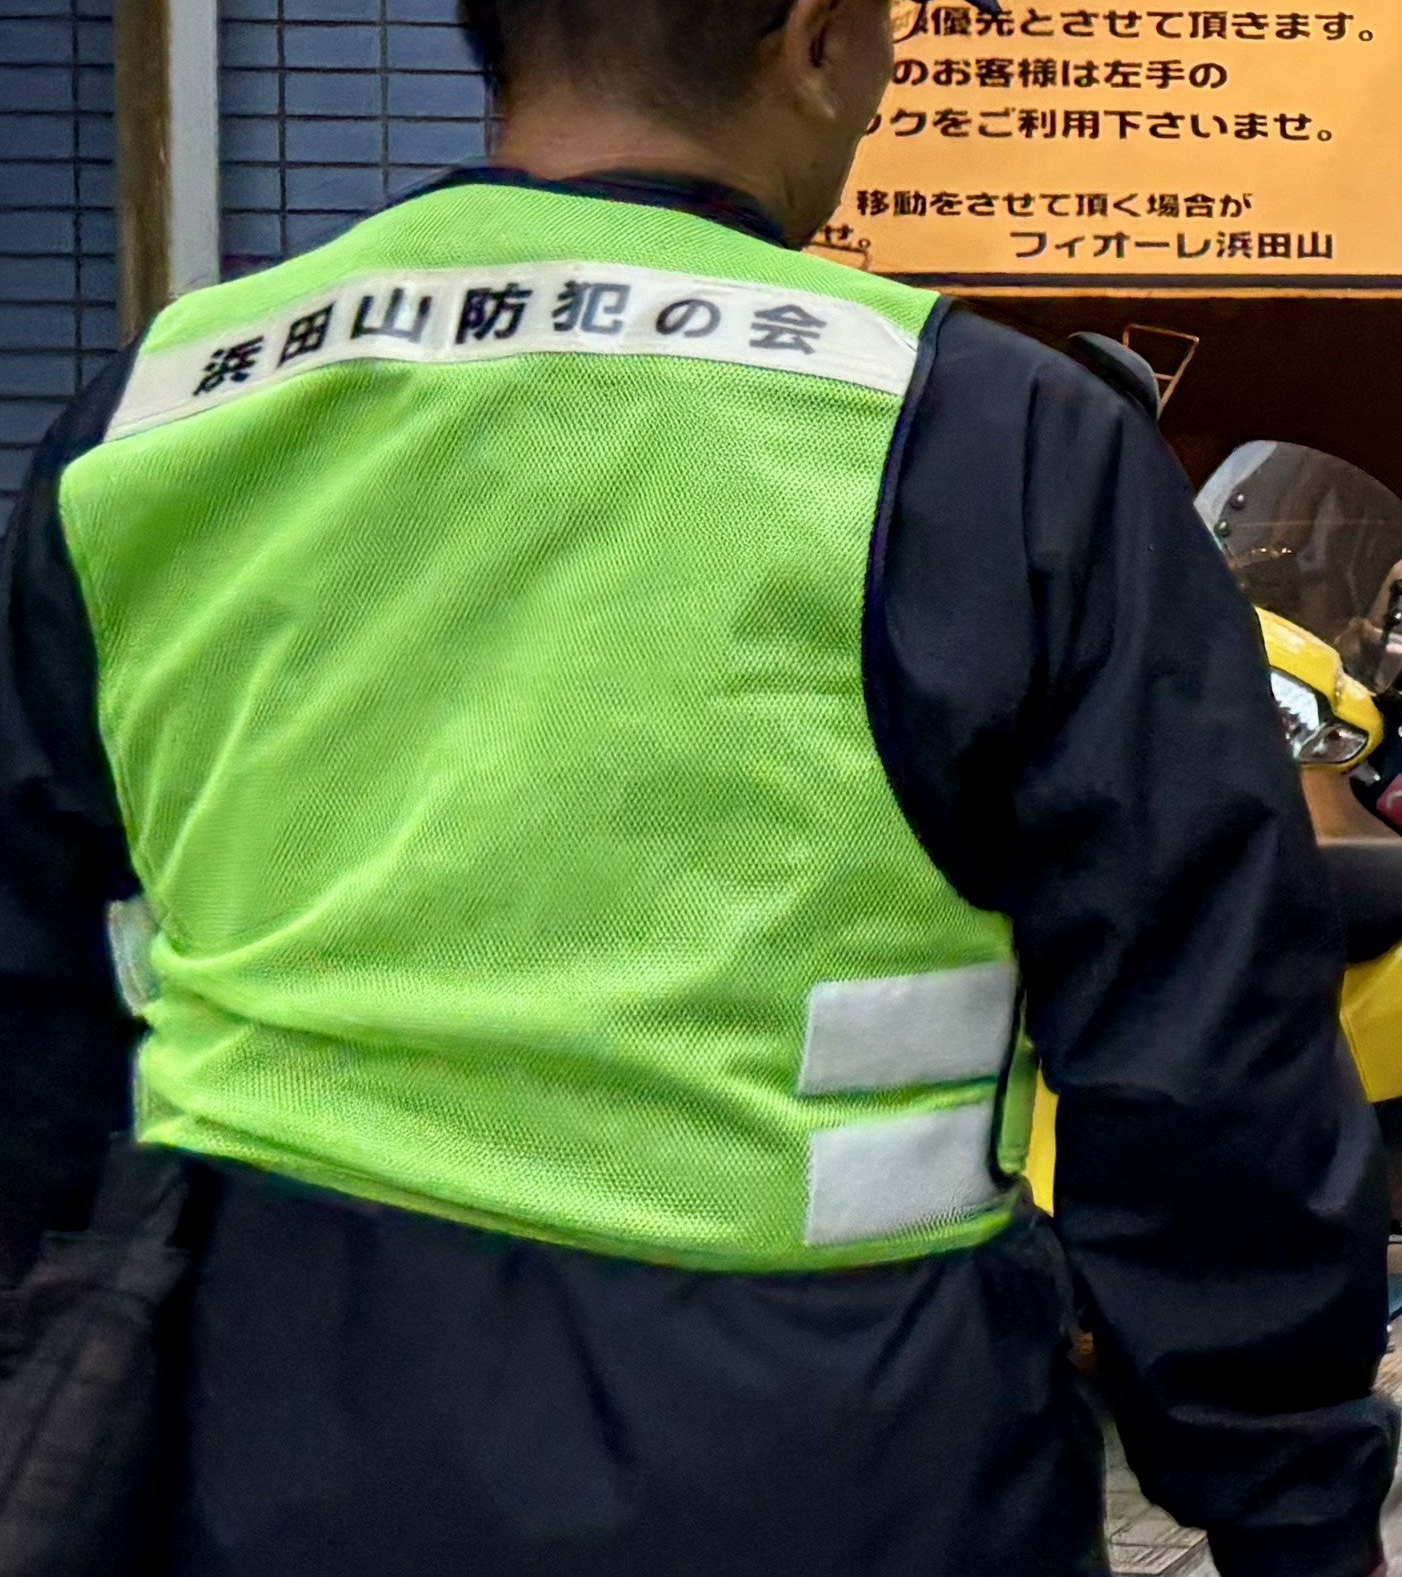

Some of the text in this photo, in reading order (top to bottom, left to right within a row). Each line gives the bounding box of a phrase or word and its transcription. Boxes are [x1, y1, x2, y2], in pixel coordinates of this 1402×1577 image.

[892, 57, 1228, 90] のお客様は左手の
[856, 189, 1253, 219] 移動をさせて頂く場合が
[1009, 230, 1334, 260] フィオーレ浜田山
[193, 279, 828, 397] 浜田山防犯の会
